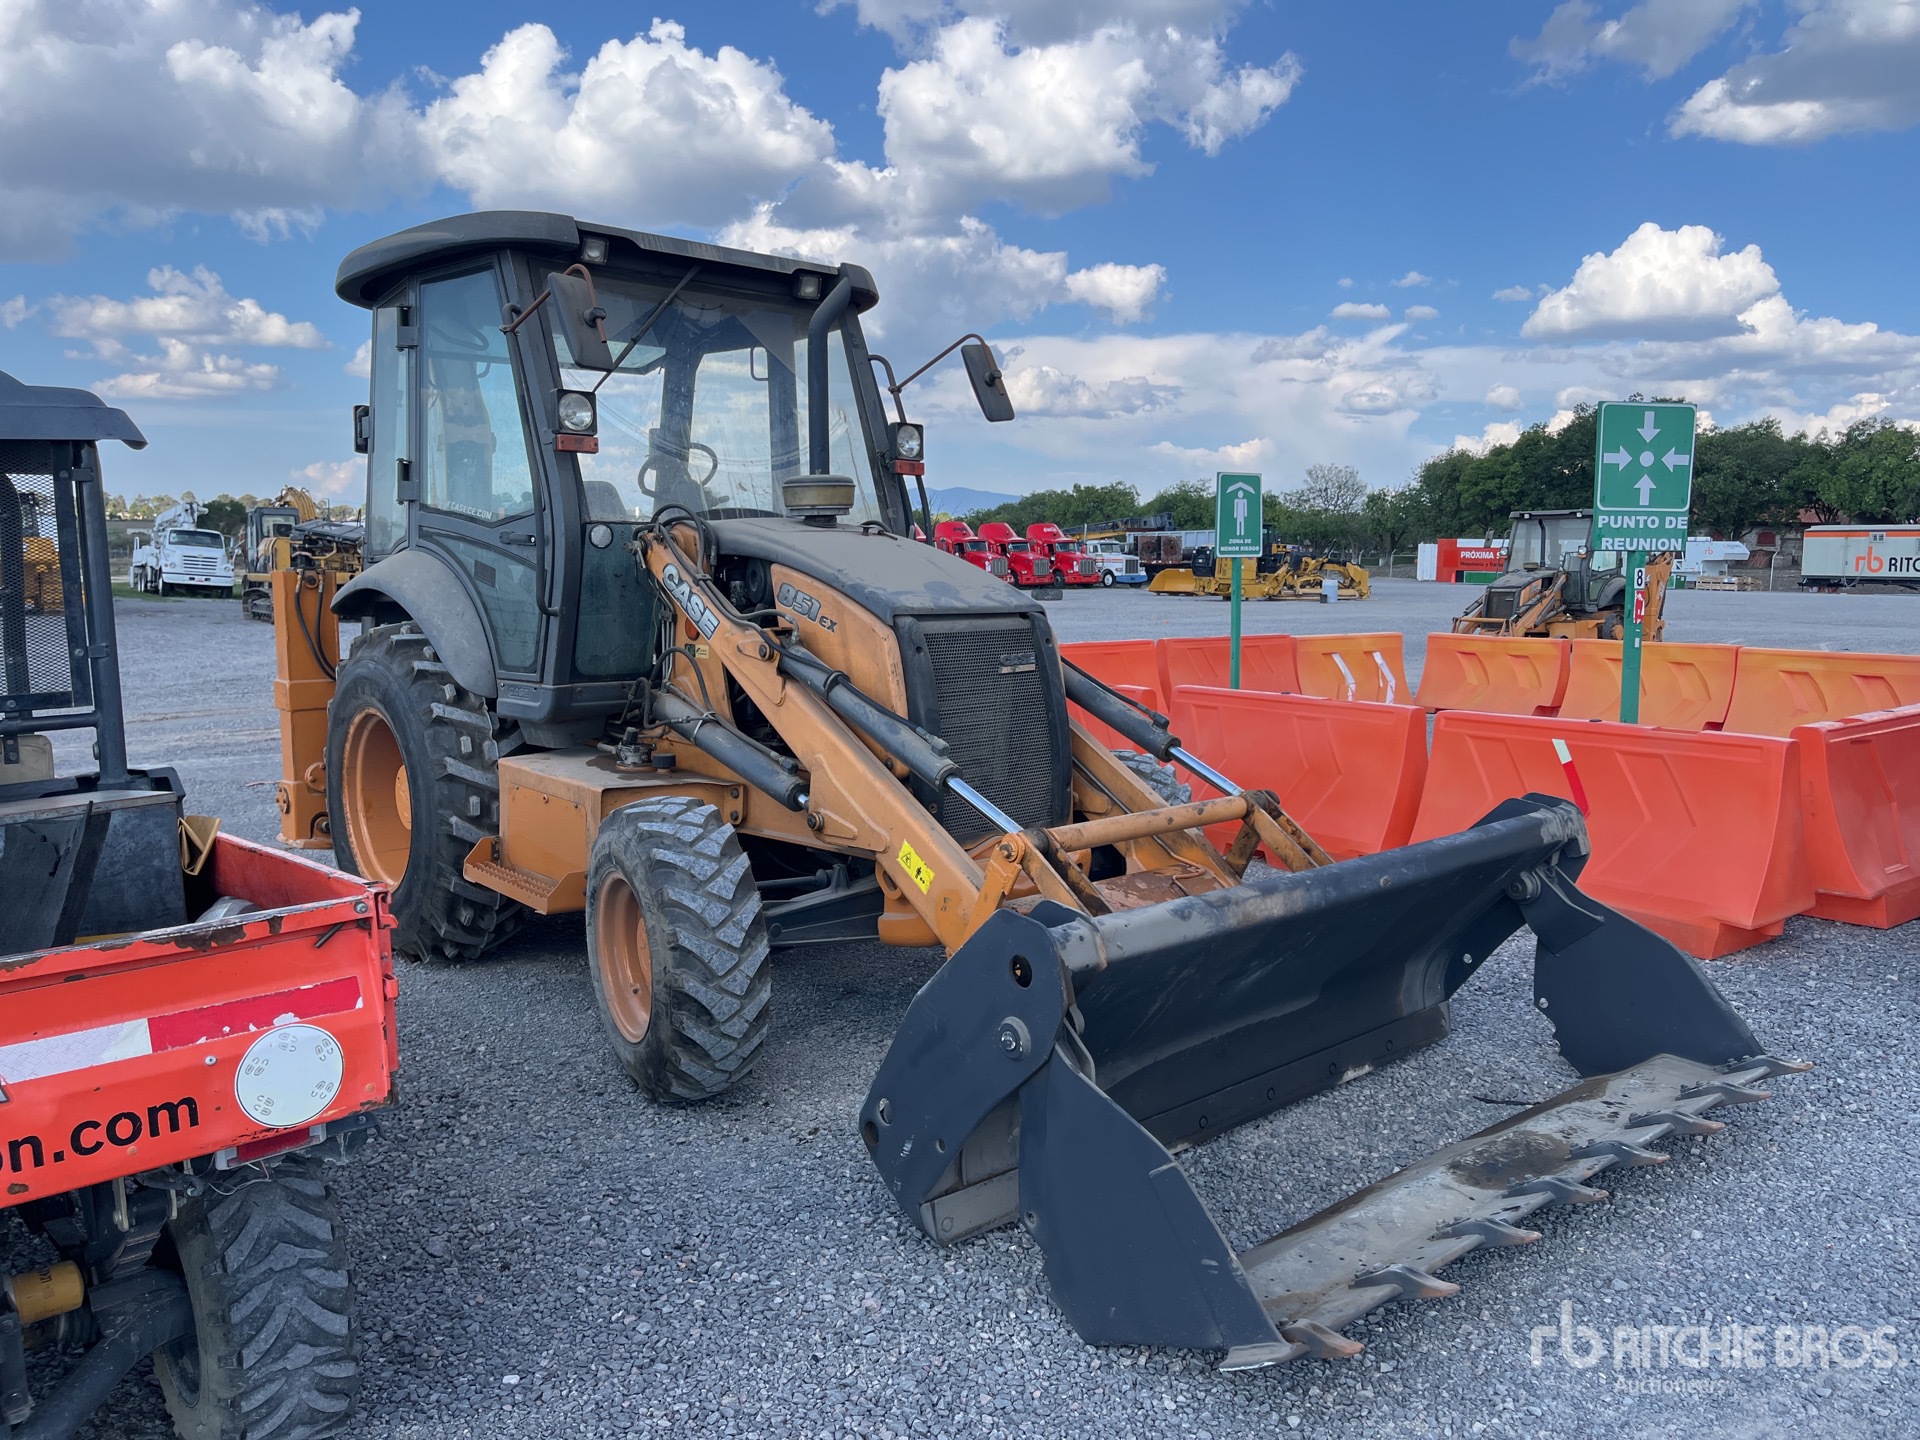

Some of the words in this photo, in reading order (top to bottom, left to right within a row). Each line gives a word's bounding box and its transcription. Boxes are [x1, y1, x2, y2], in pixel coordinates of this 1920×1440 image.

[1597, 515, 1660, 529] PUNTO
[1664, 516, 1688, 529] DE
[1460, 550, 1494, 559] PRÓXIMA
[1601, 537, 1682, 551] REUNION
[1855, 545, 1884, 573] rb
[1636, 569, 1643, 587] 8
[662, 562, 721, 642] CASE
[777, 582, 822, 624] 851
[0, 1096, 200, 1174] n.com
